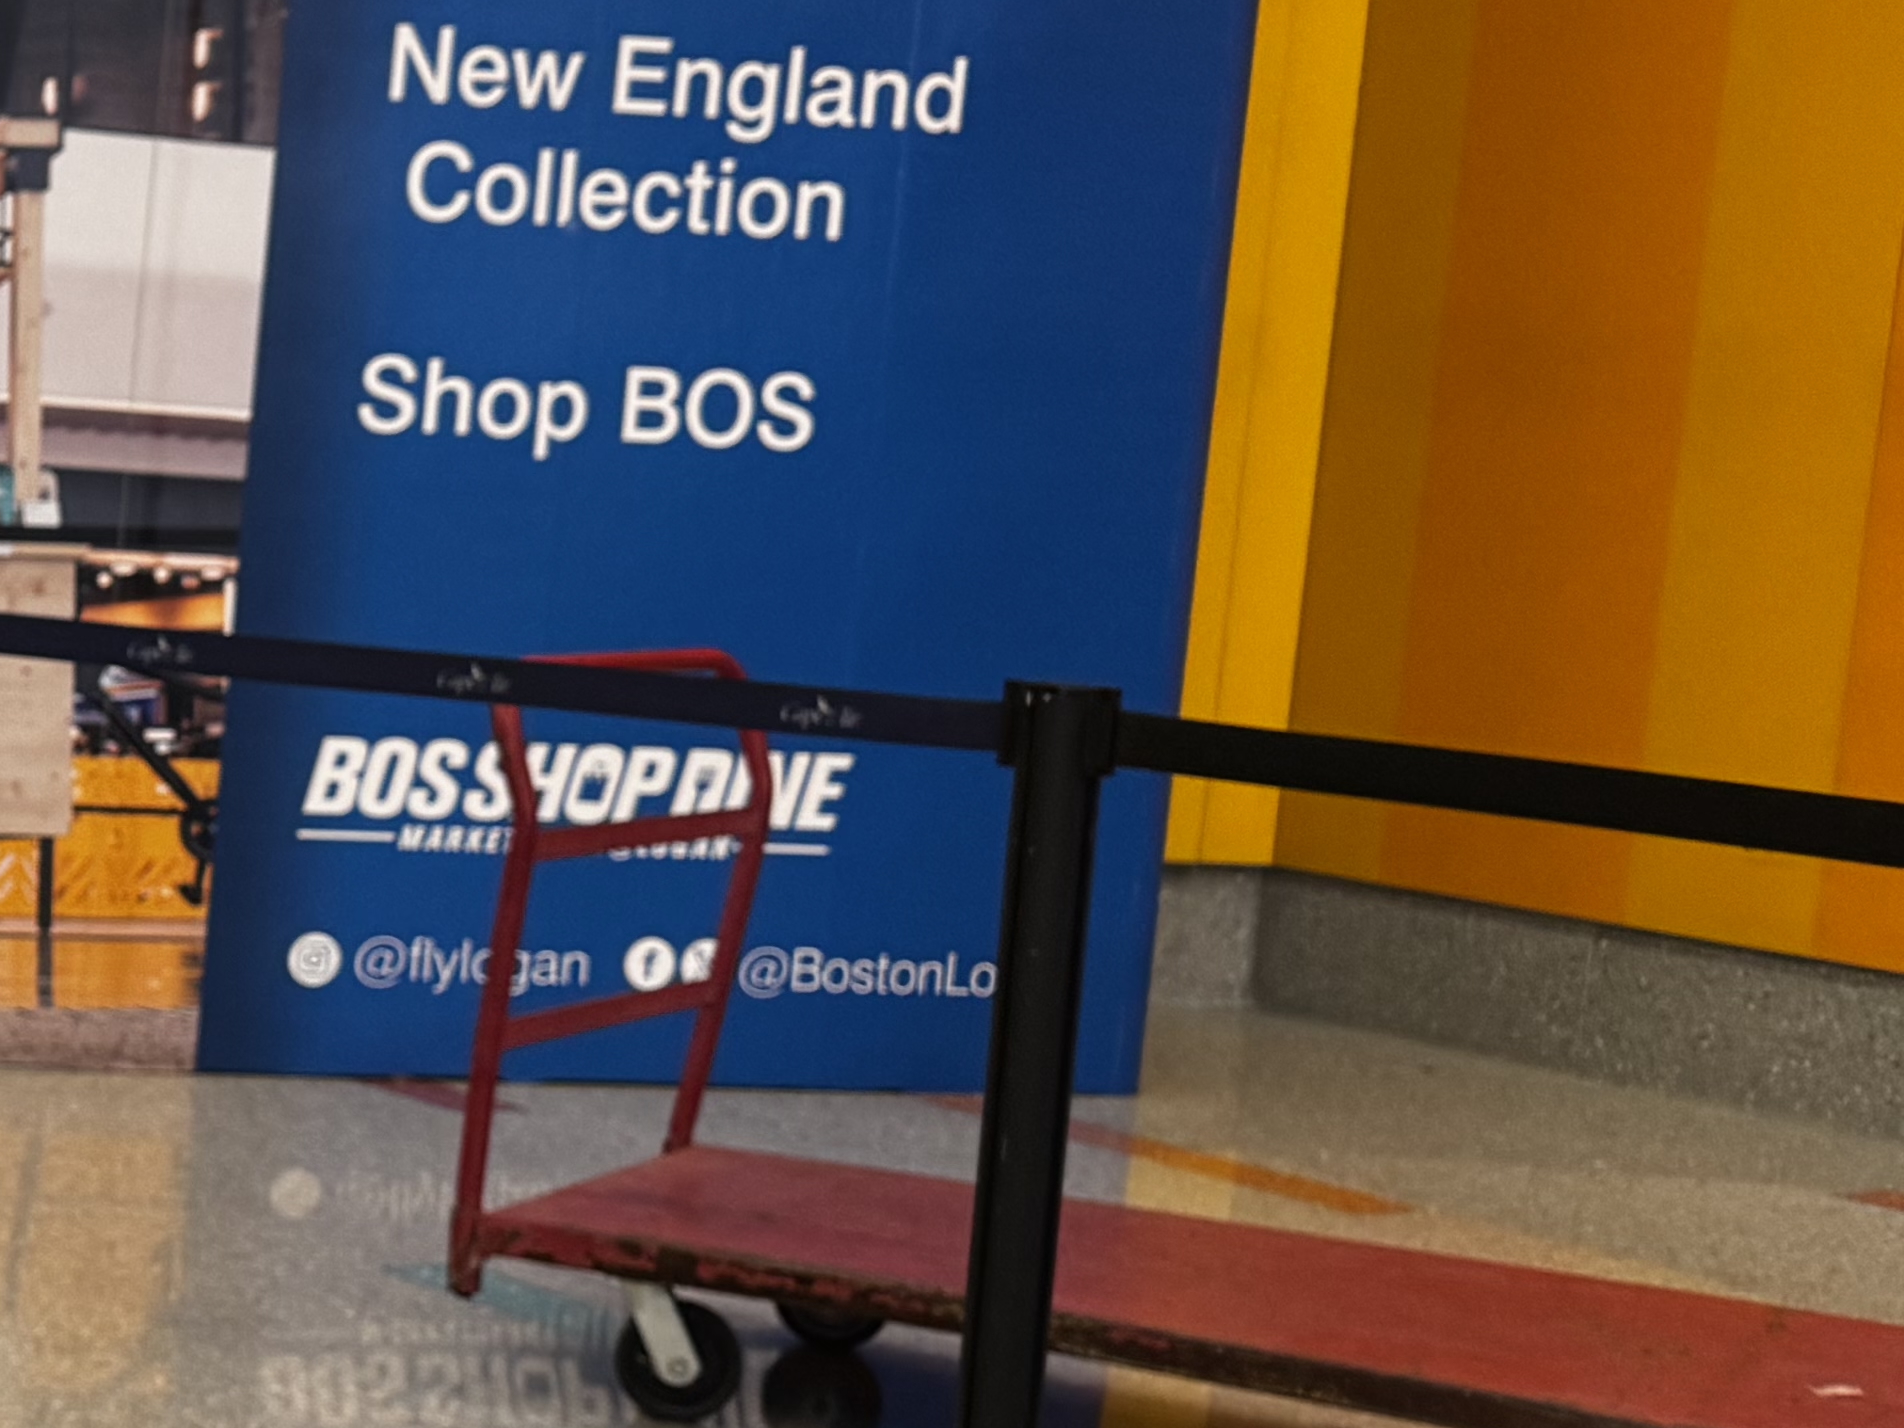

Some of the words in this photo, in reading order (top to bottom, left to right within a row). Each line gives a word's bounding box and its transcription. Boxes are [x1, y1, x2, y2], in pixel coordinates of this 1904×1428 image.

[391, 25, 582, 108] New
[614, 38, 966, 141] England
[409, 142, 842, 239] Collection
[360, 356, 585, 458] Shop
[623, 368, 812, 450] BOS
[302, 735, 470, 820] BOS
[397, 823, 514, 855] MARKET
[739, 945, 998, 1000] @BostonLo
